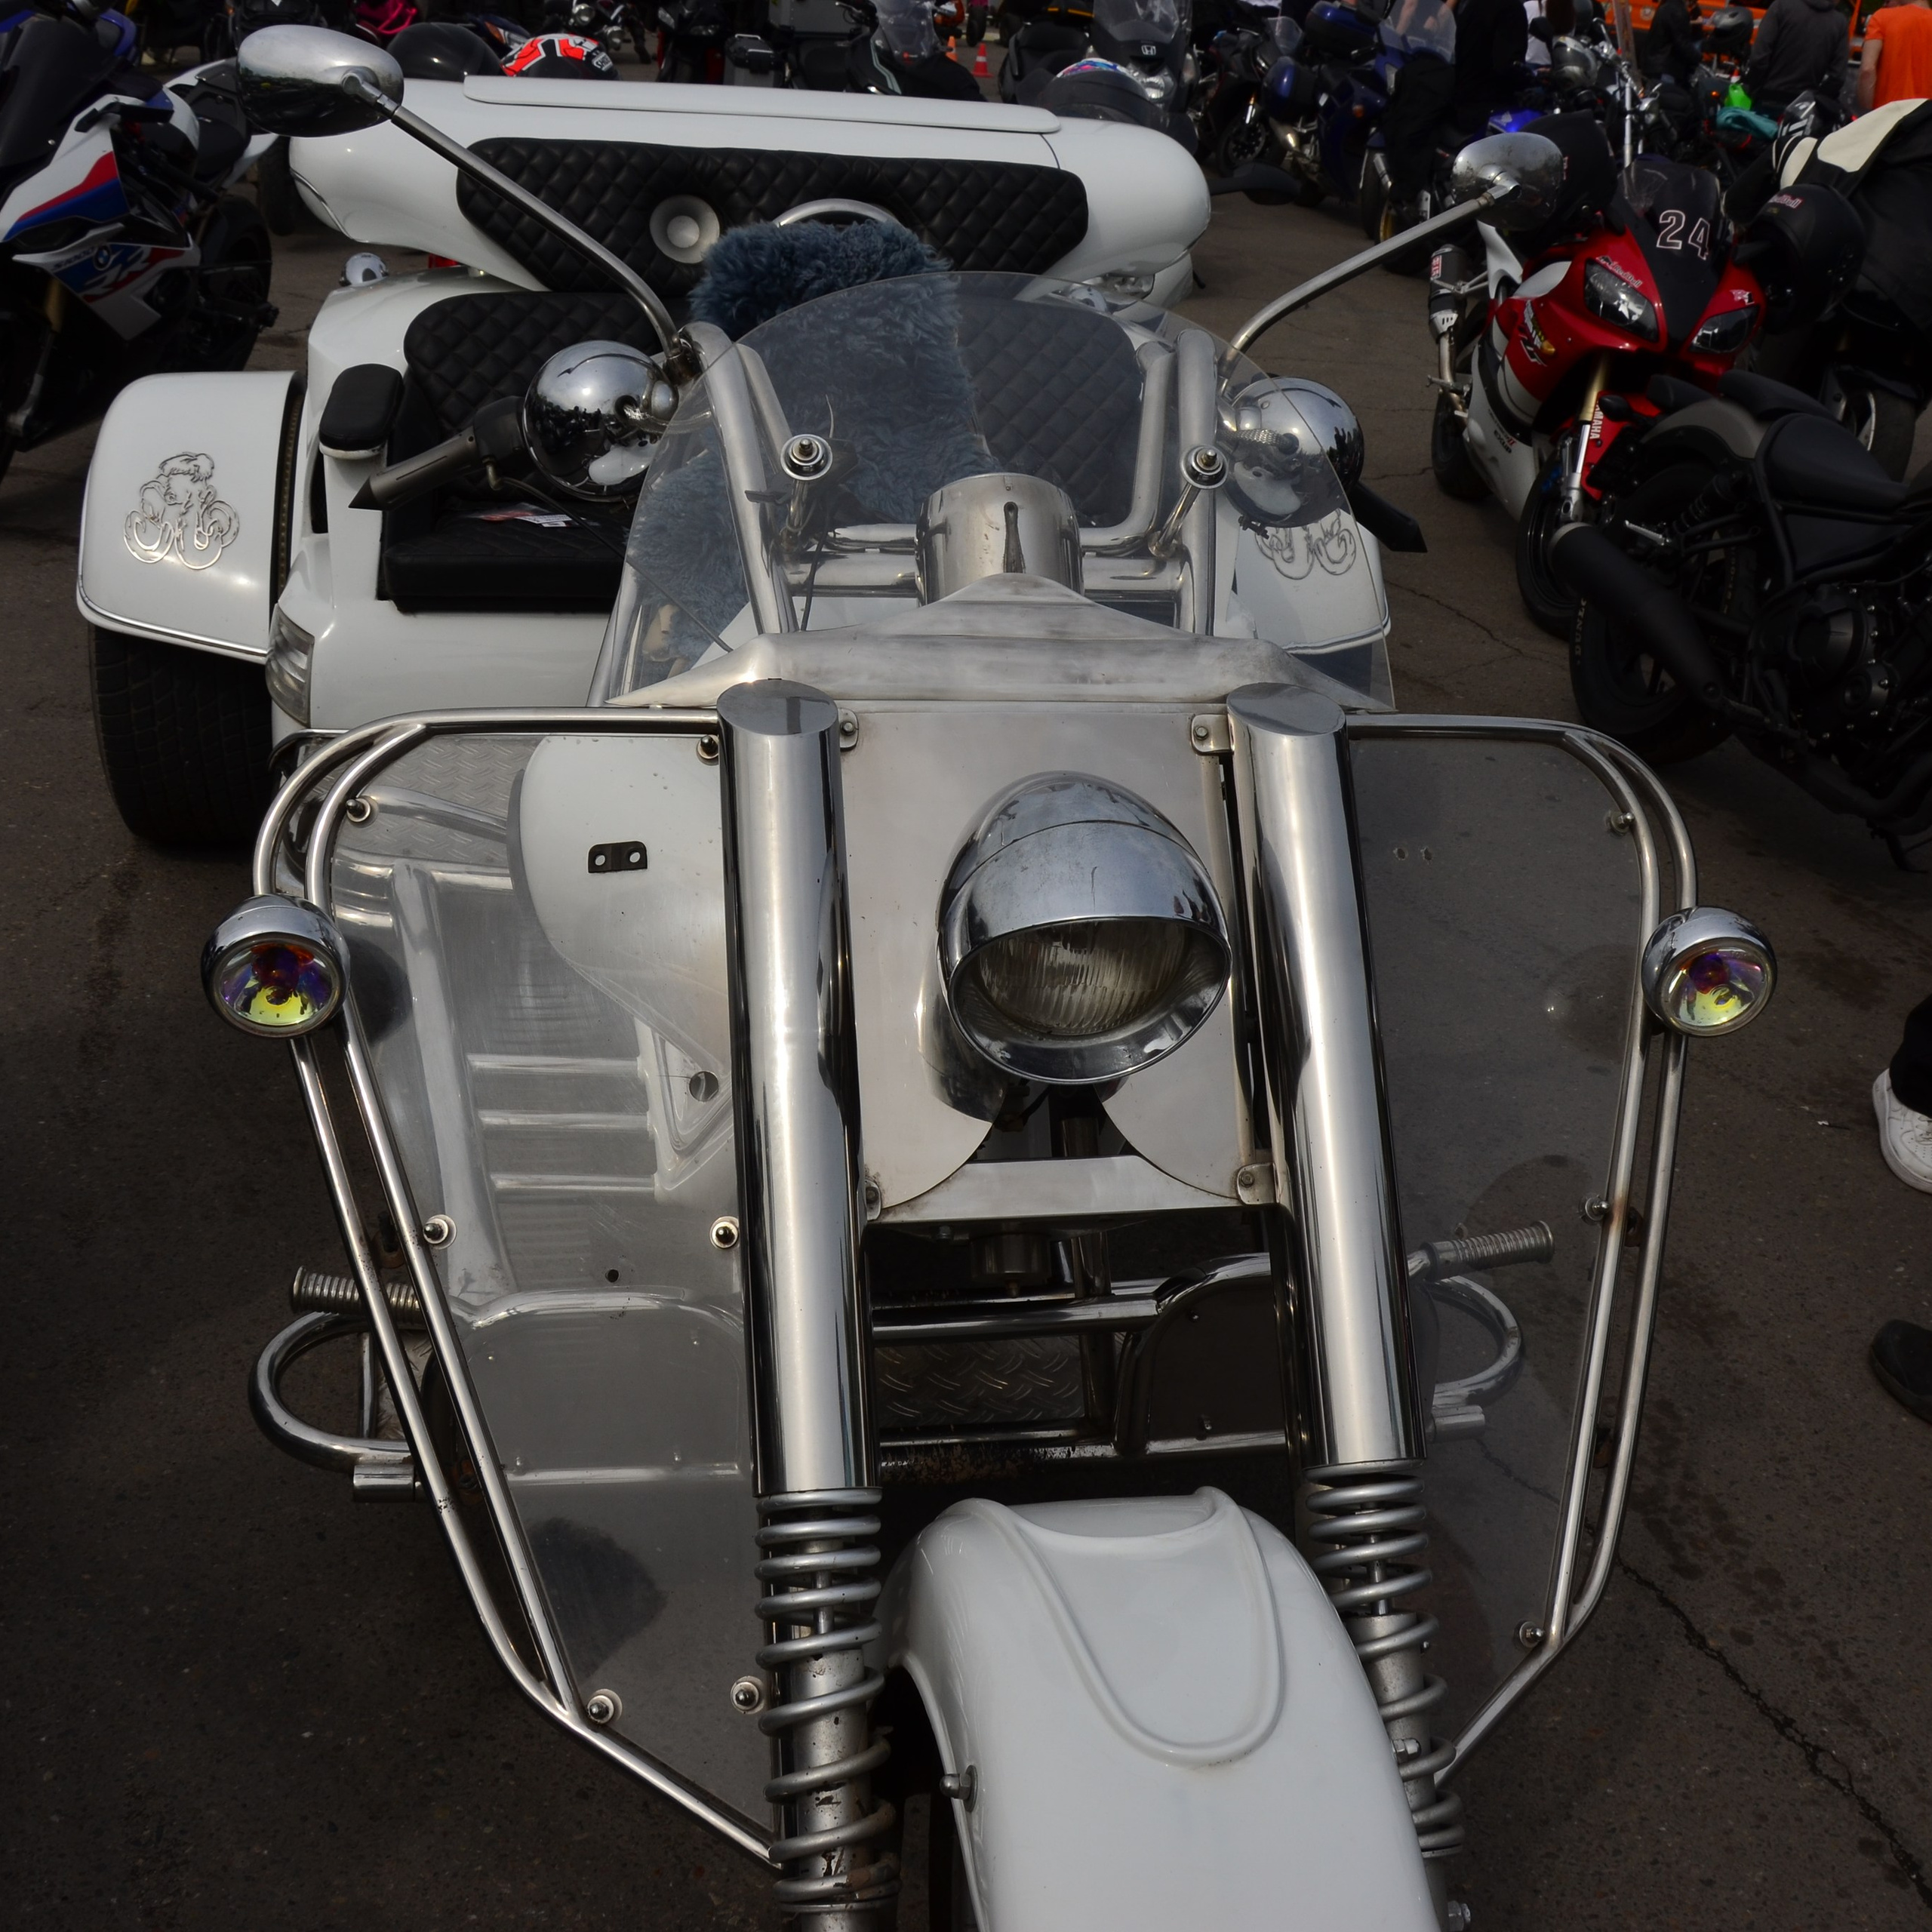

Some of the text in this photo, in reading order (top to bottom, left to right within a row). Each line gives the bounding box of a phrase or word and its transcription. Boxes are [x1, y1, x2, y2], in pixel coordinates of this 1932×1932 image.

[1656, 209, 1710, 260] 24
[1589, 401, 1604, 439] AMAHA
[1574, 597, 1588, 656] DUNLO
